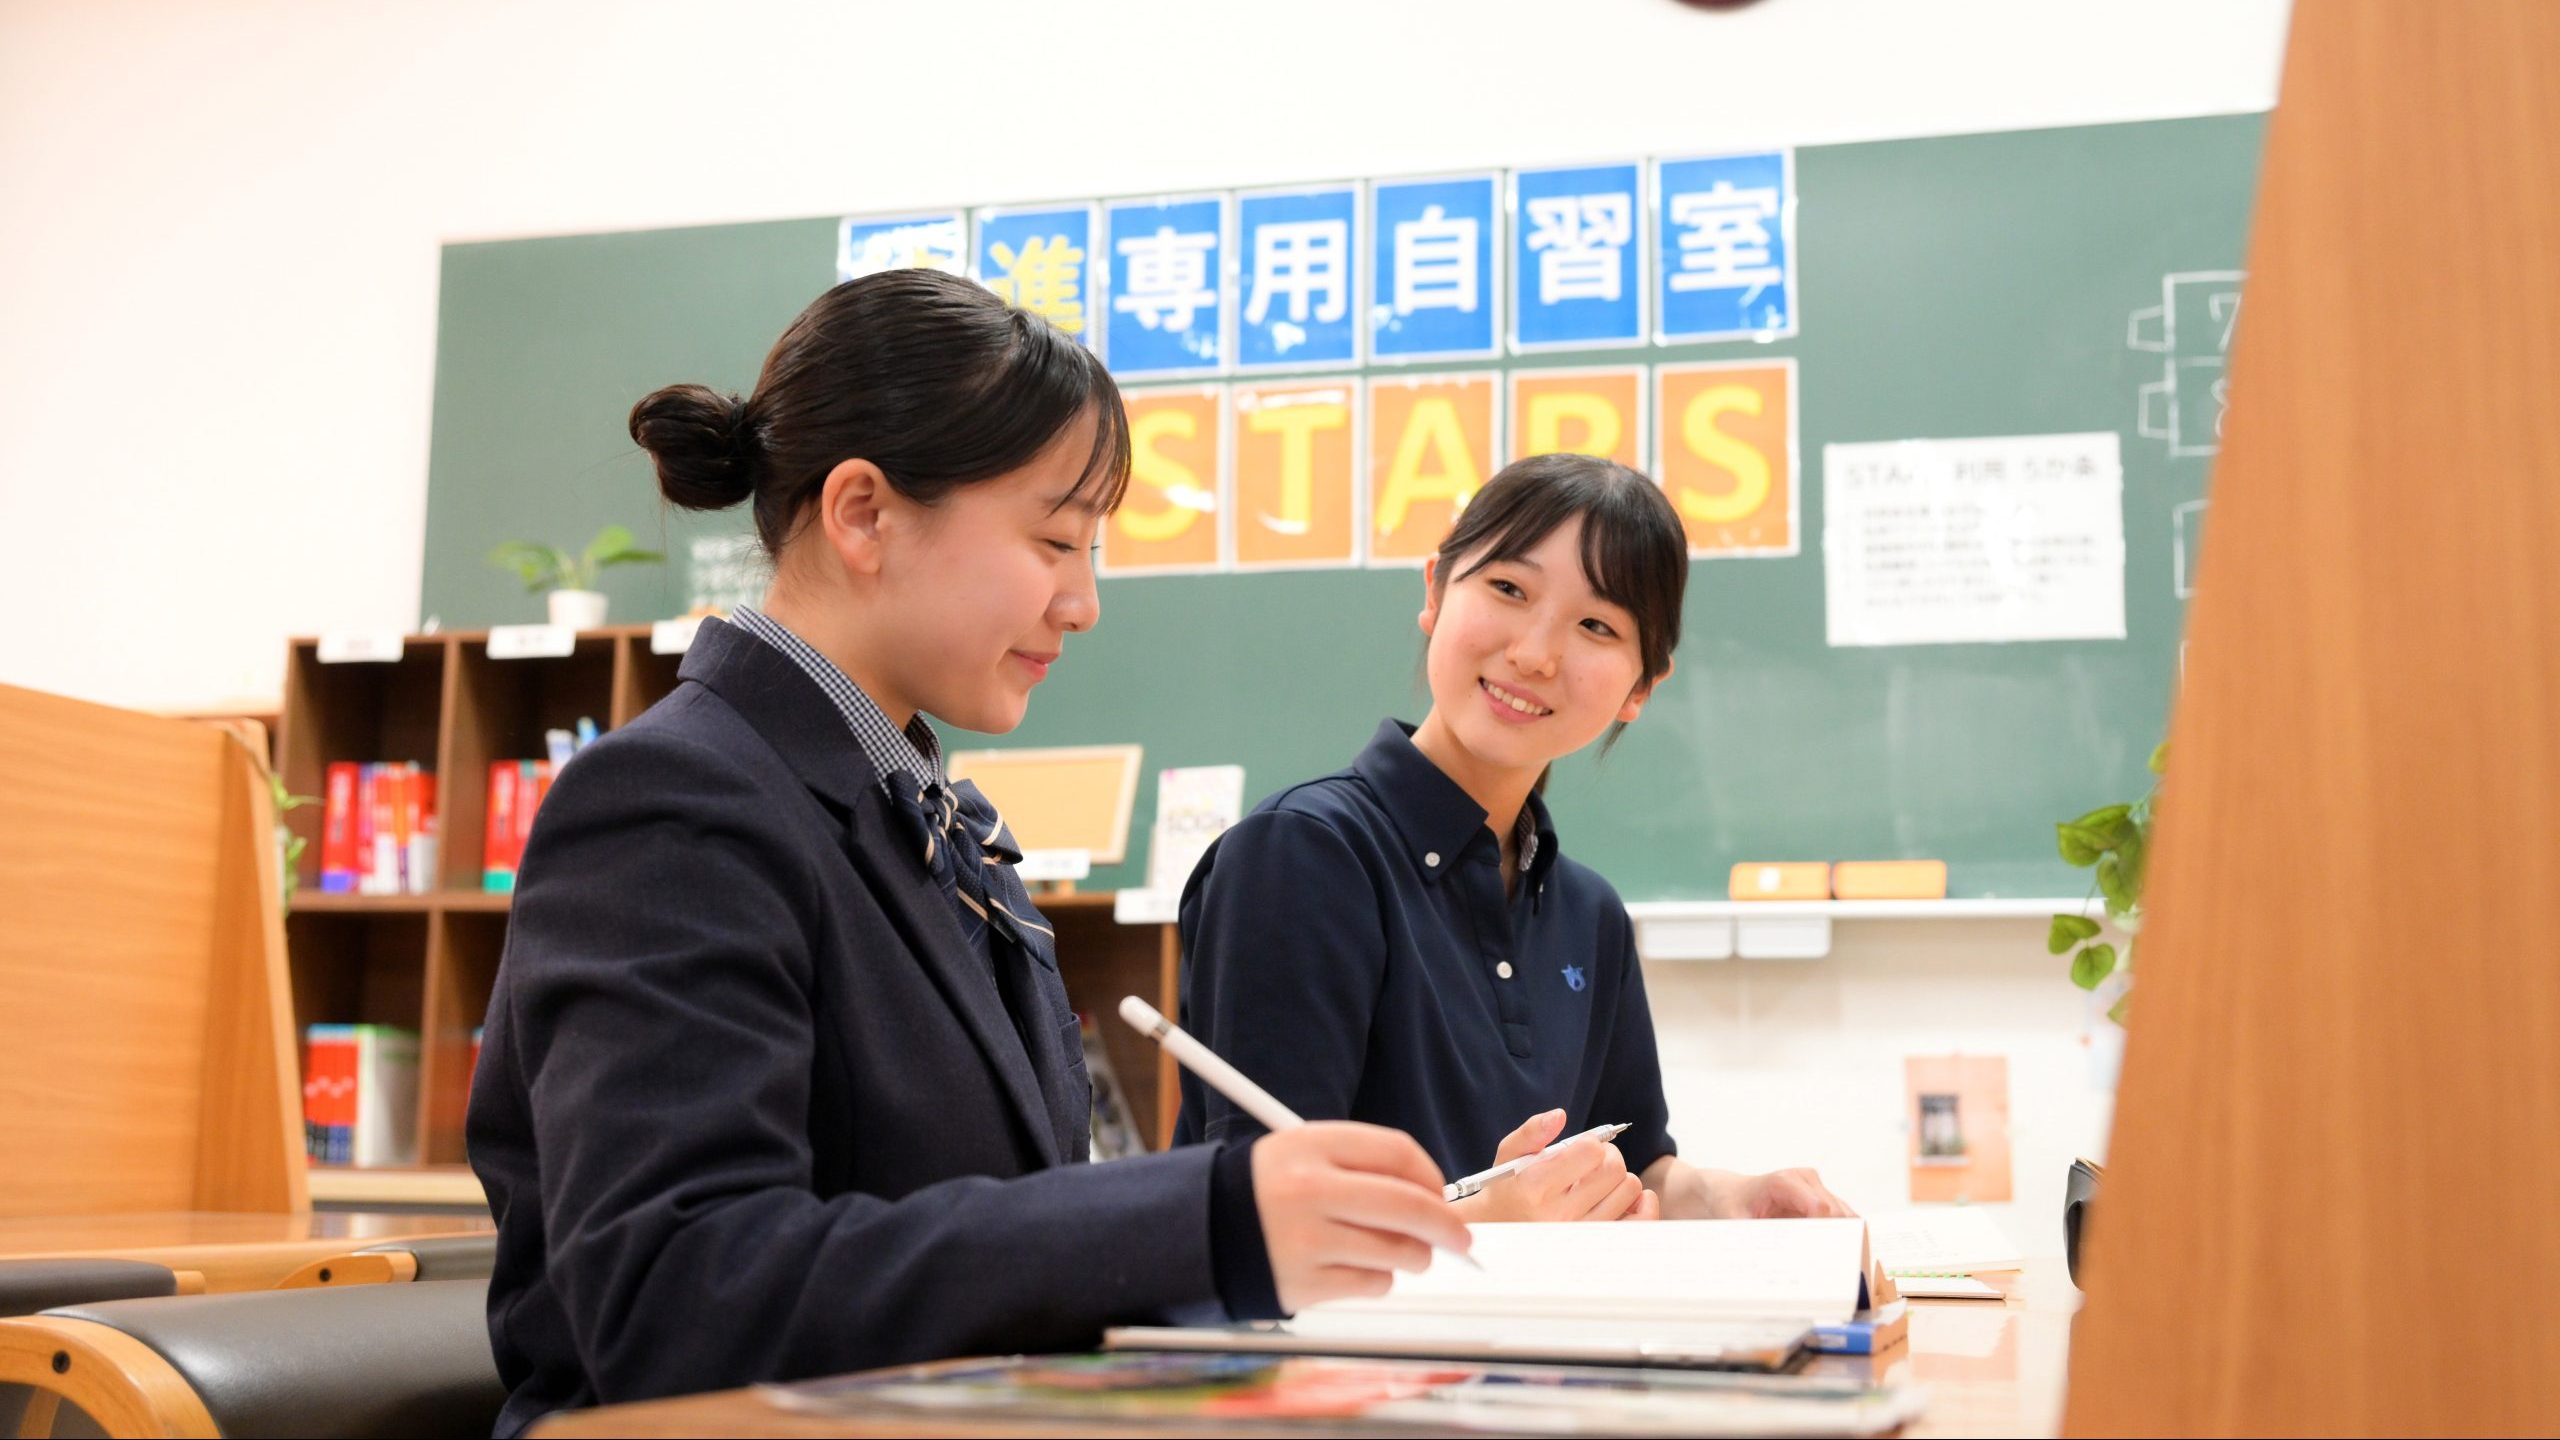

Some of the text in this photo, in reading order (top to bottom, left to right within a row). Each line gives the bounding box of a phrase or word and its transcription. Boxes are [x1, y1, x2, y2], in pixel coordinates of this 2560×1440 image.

[866, 181, 1782, 334] 進専用自習室
